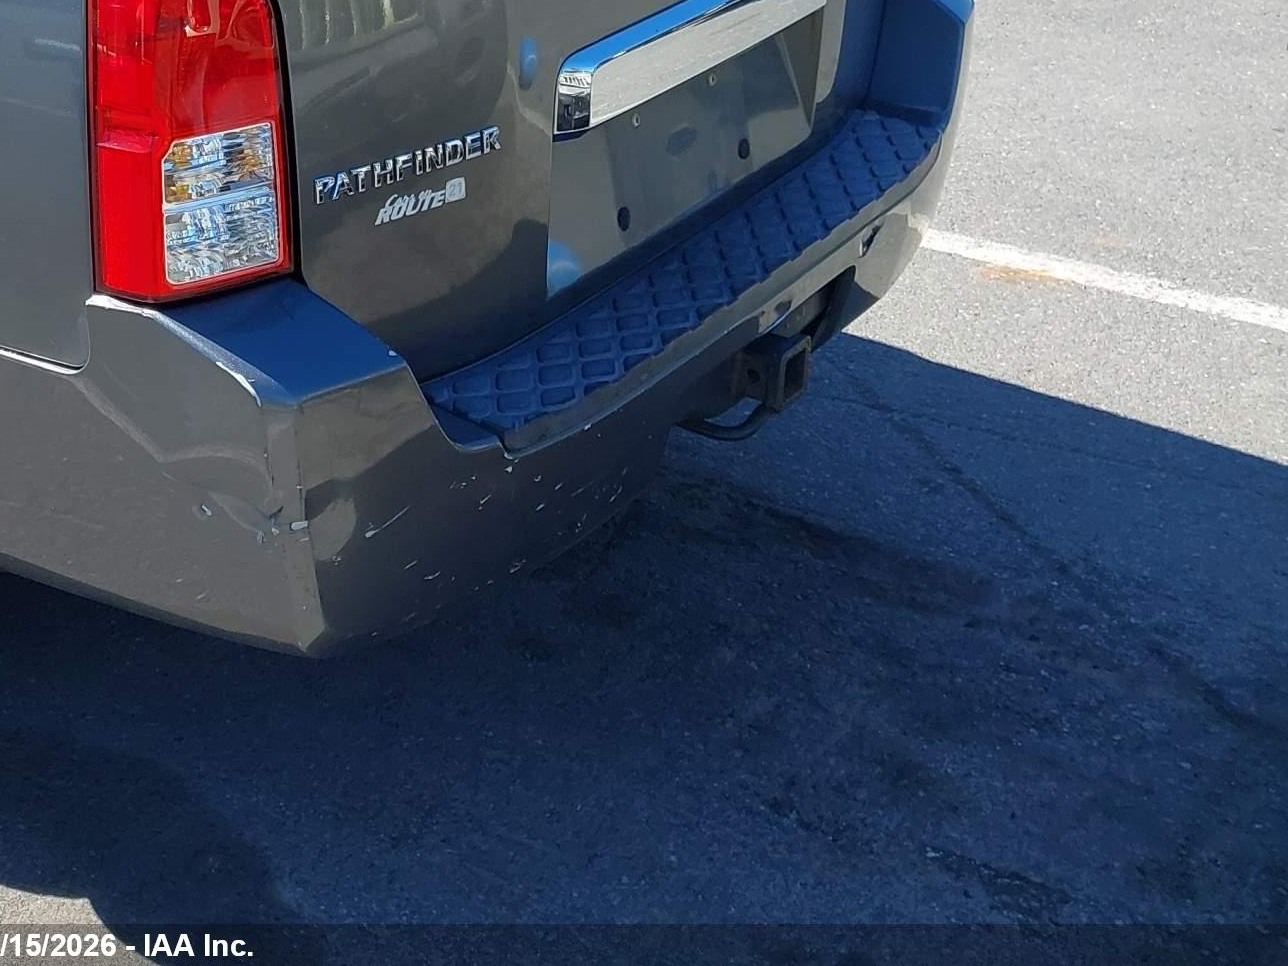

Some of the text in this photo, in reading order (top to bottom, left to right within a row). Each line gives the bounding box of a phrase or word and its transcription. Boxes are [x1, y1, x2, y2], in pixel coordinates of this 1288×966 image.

[314, 126, 502, 205] PATHFINDER
[374, 189, 446, 226] ROUTE
[447, 179, 465, 199] 21
